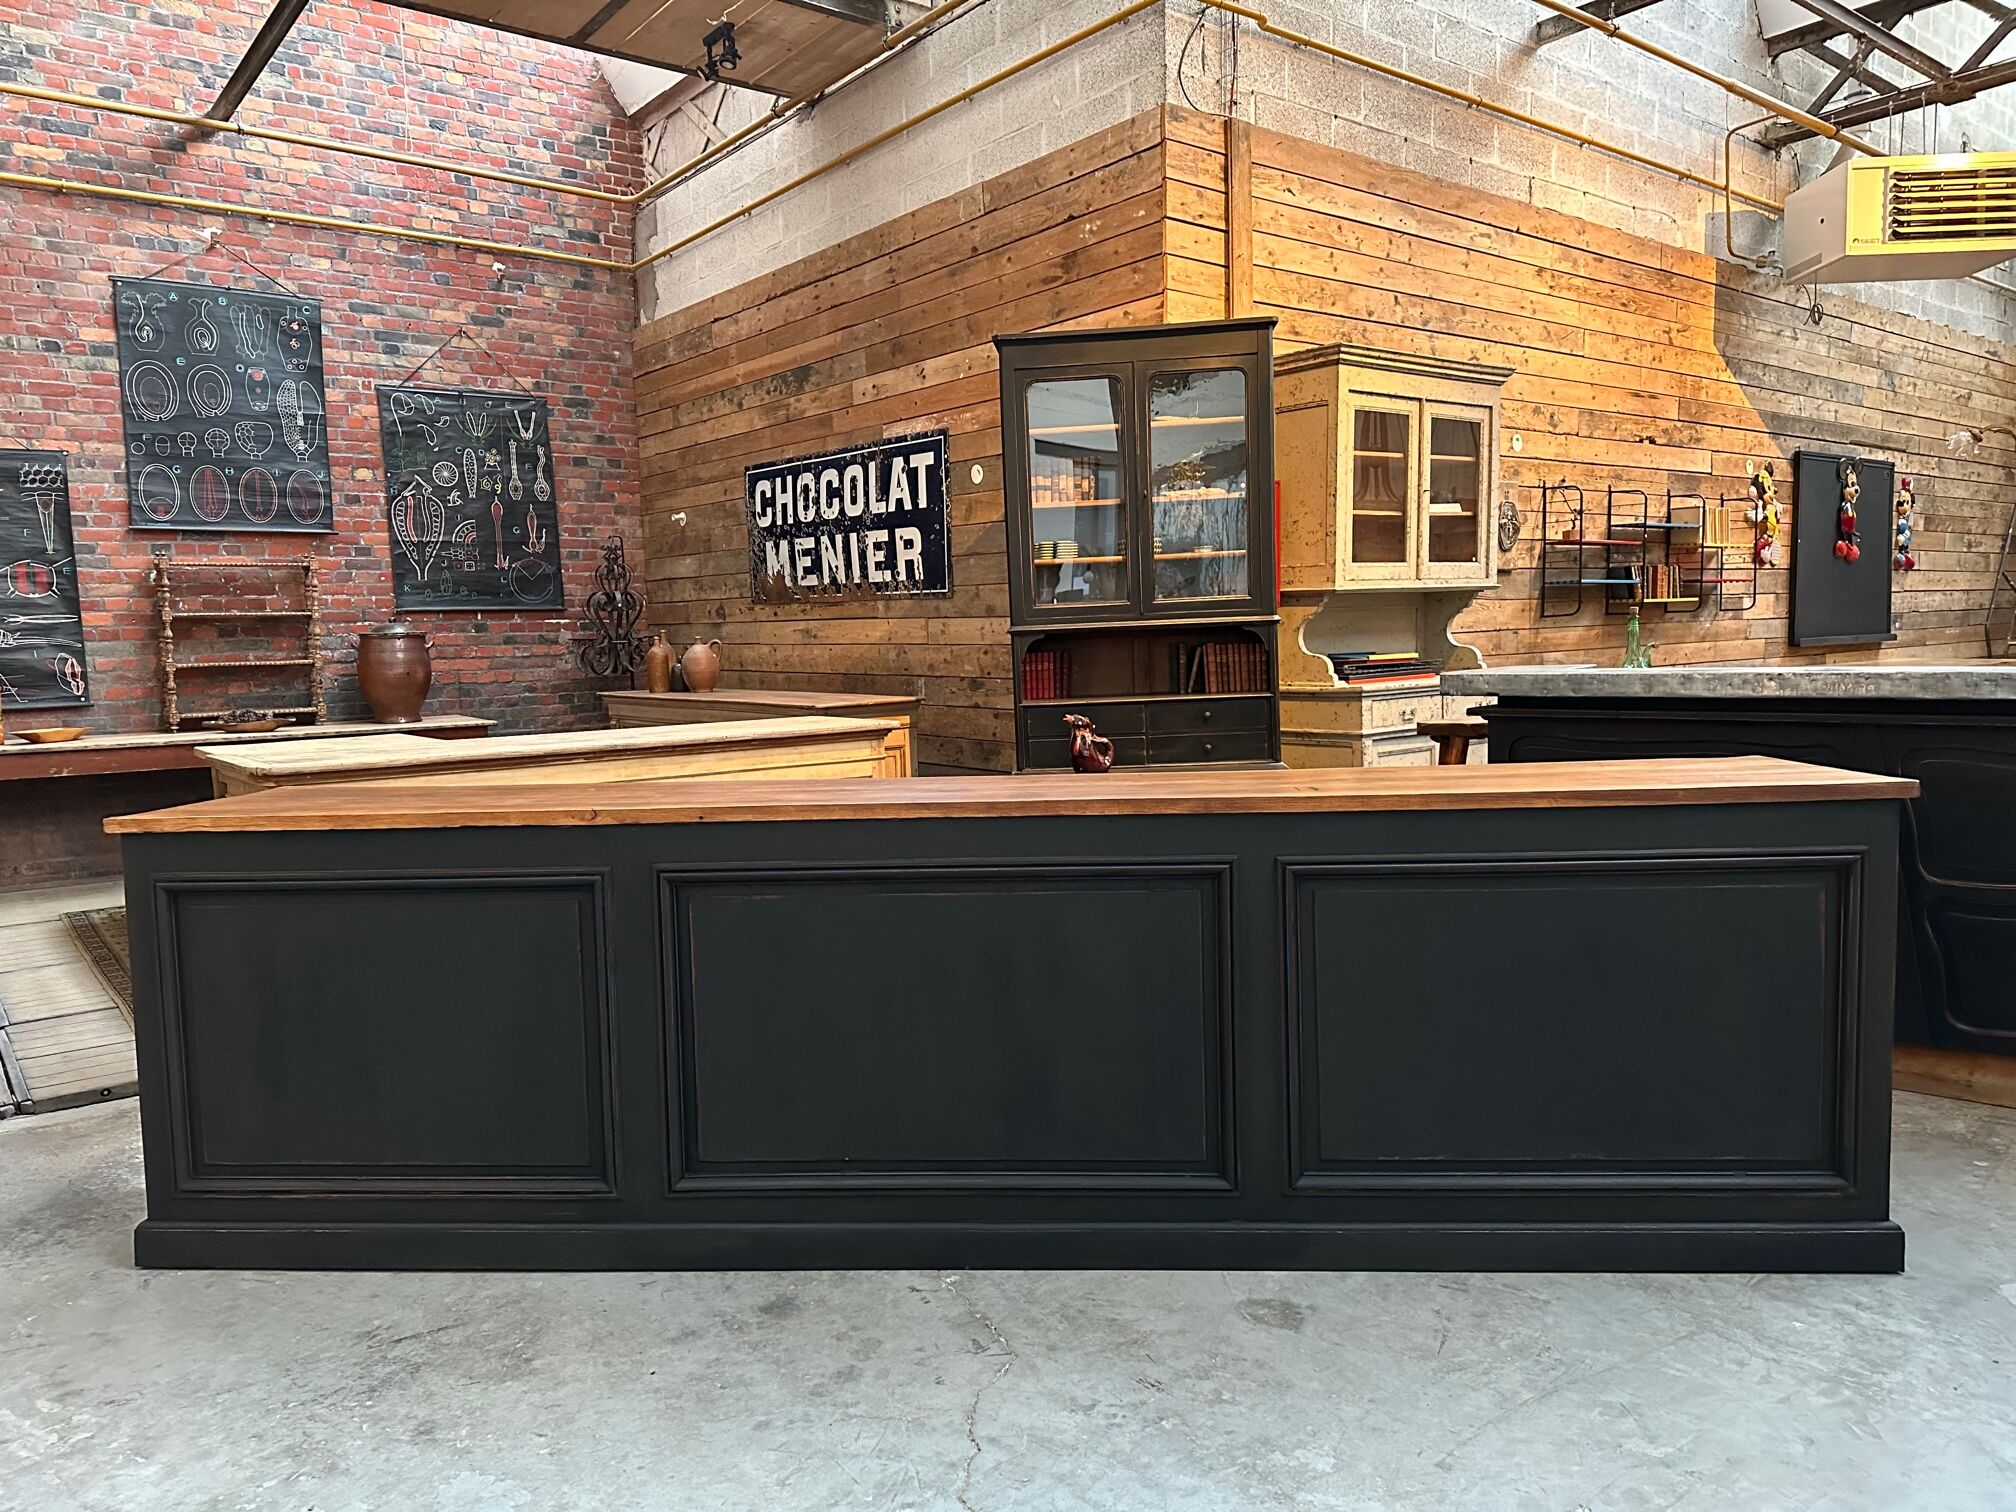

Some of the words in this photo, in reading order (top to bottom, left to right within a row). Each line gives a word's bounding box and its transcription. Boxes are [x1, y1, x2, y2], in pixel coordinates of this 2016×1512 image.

[434, 396, 442, 404] A
[172, 465, 182, 474] G
[755, 452, 934, 528] CHOCOLAT
[23, 528, 32, 537] F
[512, 526, 521, 534] G
[765, 527, 924, 589] MENIER
[62, 567, 72, 575] E
[404, 584, 412, 592] K
